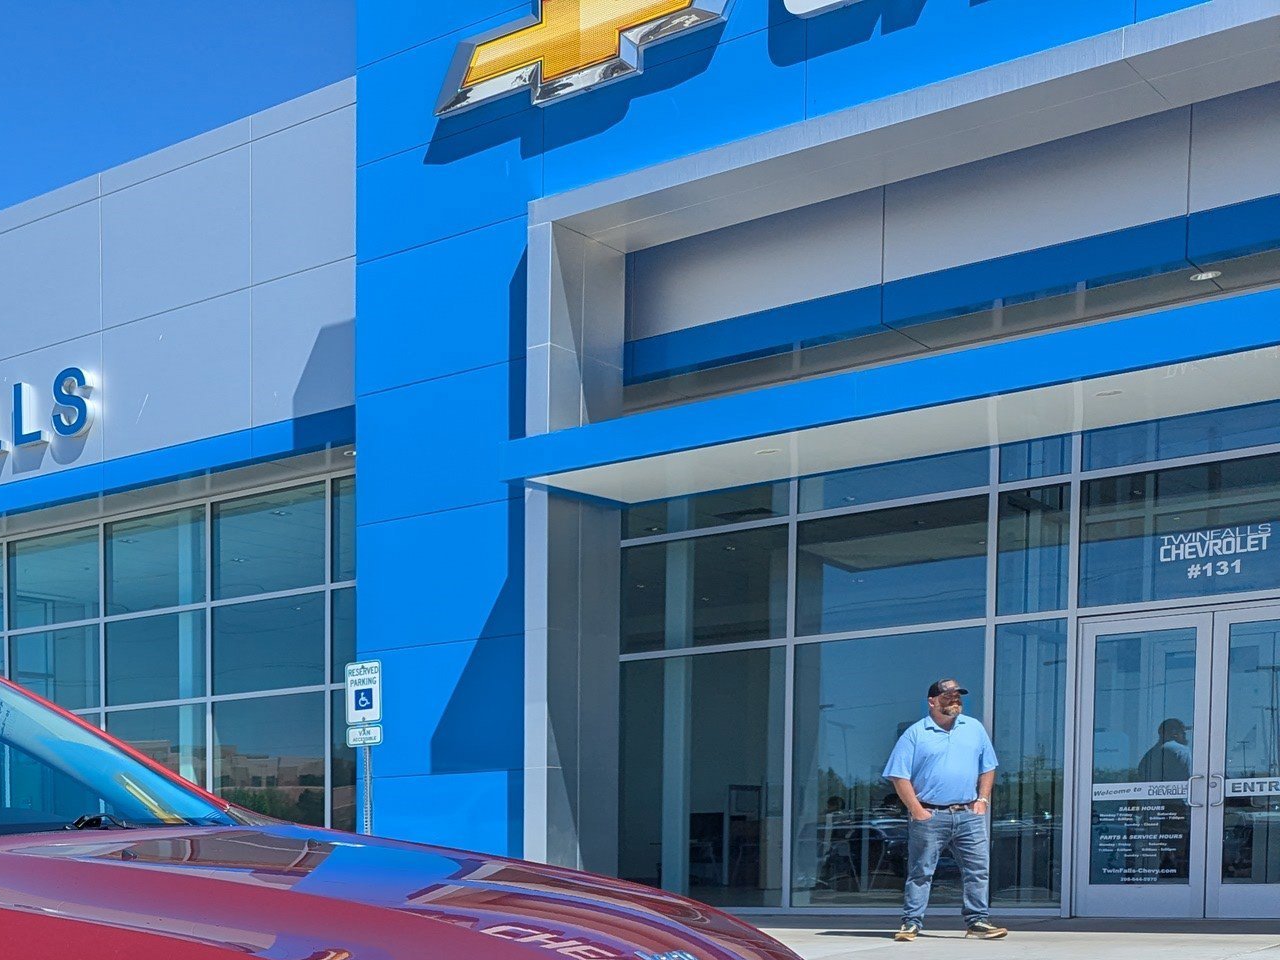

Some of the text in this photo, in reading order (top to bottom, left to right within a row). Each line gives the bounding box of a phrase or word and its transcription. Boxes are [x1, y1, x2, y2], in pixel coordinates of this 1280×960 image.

[1160, 523, 1271, 546] TWINFALLS
[1160, 533, 1271, 562] CHEVROLET
[1187, 559, 1241, 579] #131
[348, 666, 379, 677] RESERVED
[350, 677, 377, 687] PARKING
[1094, 788, 1132, 797] Welcome
[1148, 788, 1187, 796] CHEVROLE
